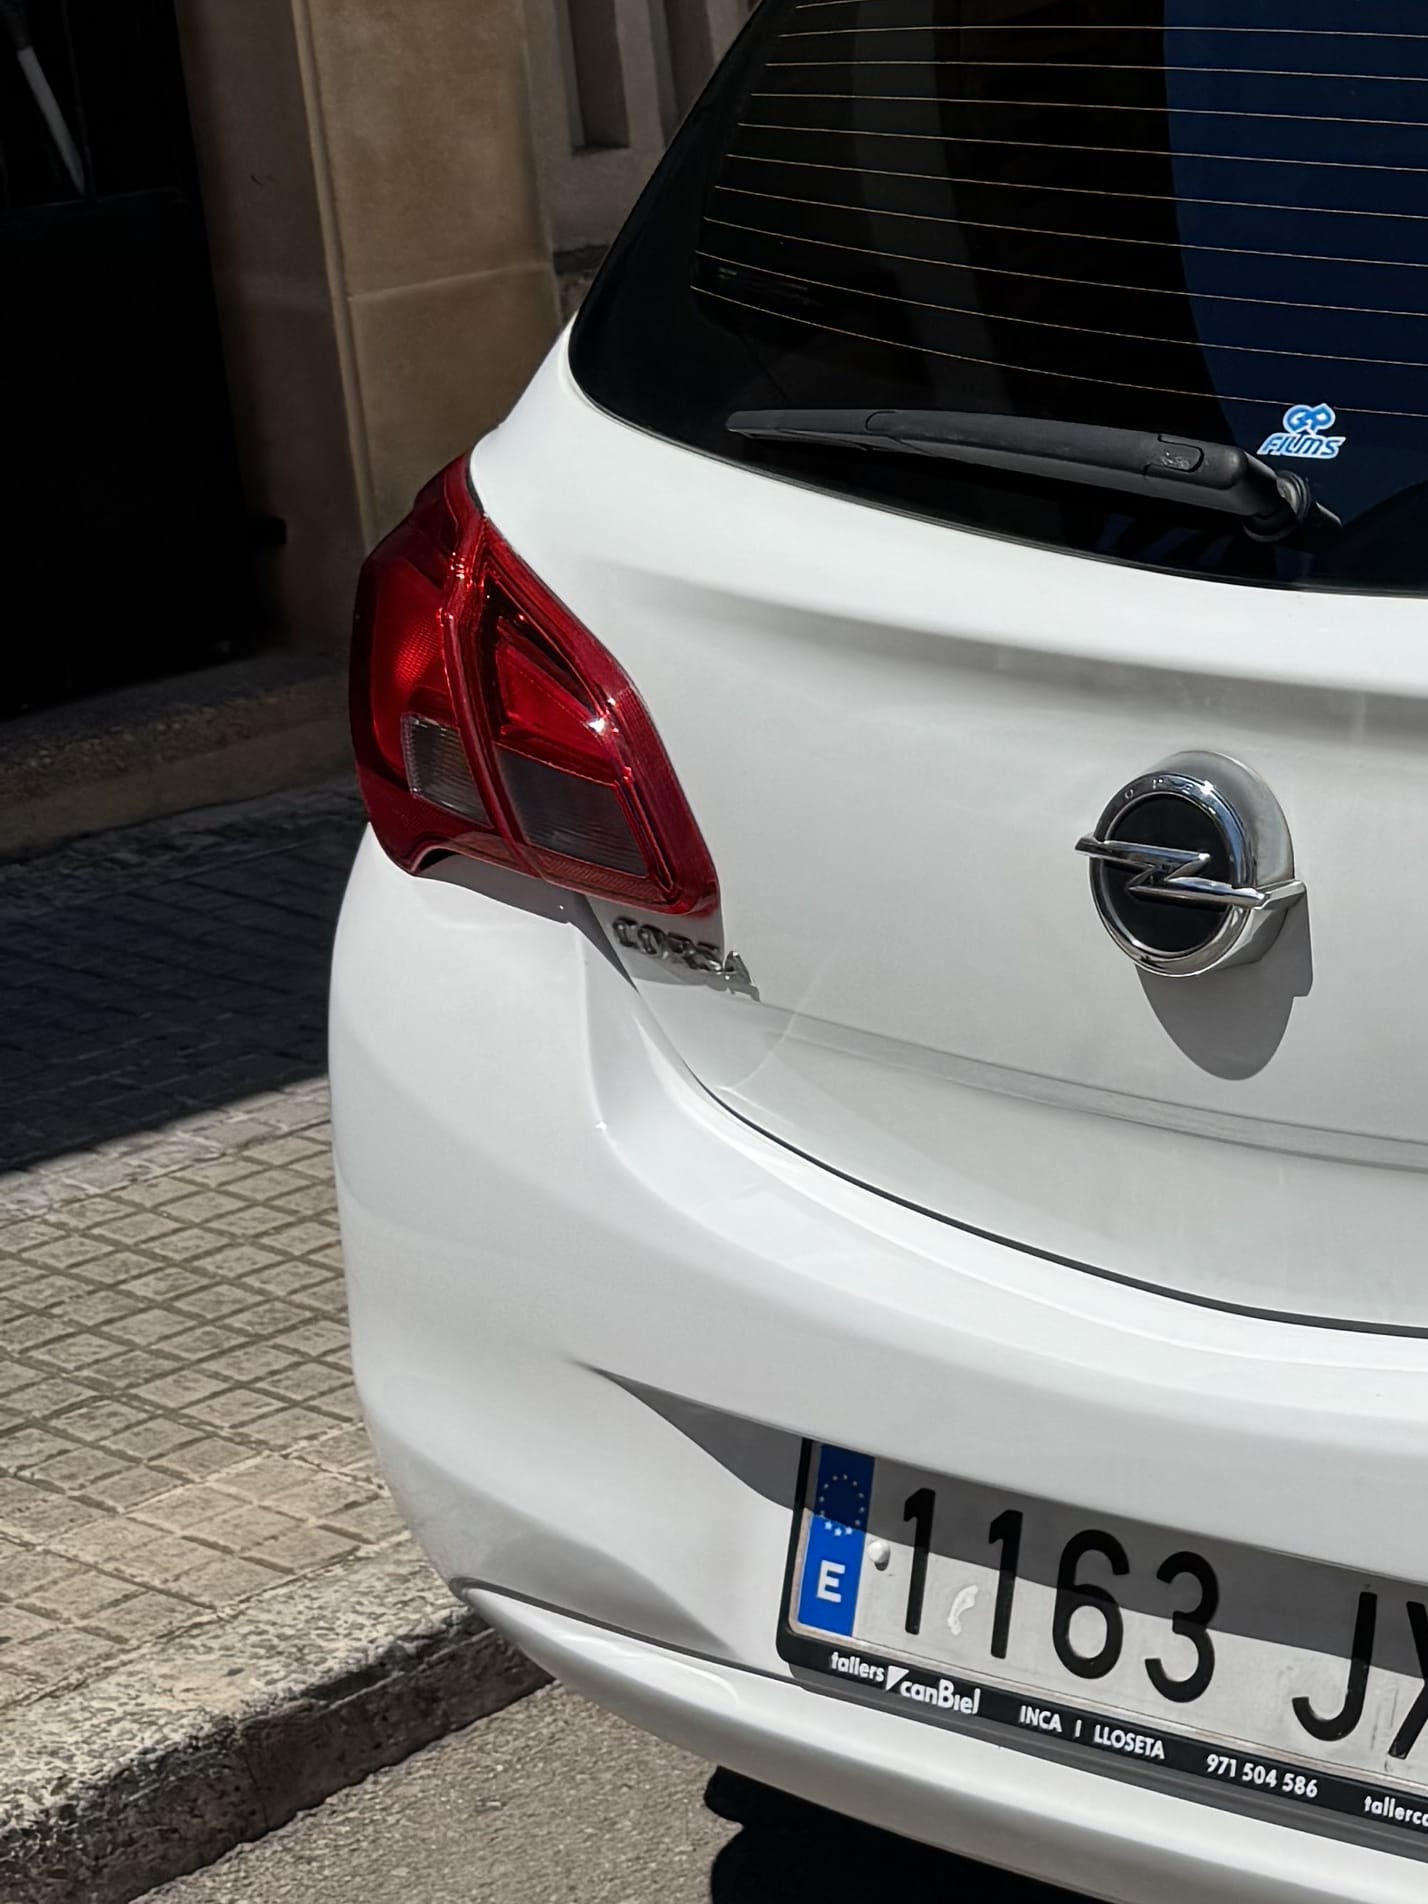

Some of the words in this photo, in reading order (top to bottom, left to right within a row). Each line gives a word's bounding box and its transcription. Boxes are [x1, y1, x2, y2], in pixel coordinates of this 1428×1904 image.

[816, 1559, 846, 1603] E
[904, 1487, 1220, 1703] 1163
[831, 1652, 885, 1683] tallers
[1019, 1705, 1062, 1733] INCA
[1094, 1724, 1165, 1760] LLOSETA
[1206, 1754, 1237, 1778] 971
[1242, 1762, 1277, 1788] 504
[1282, 1772, 1318, 1798] 586
